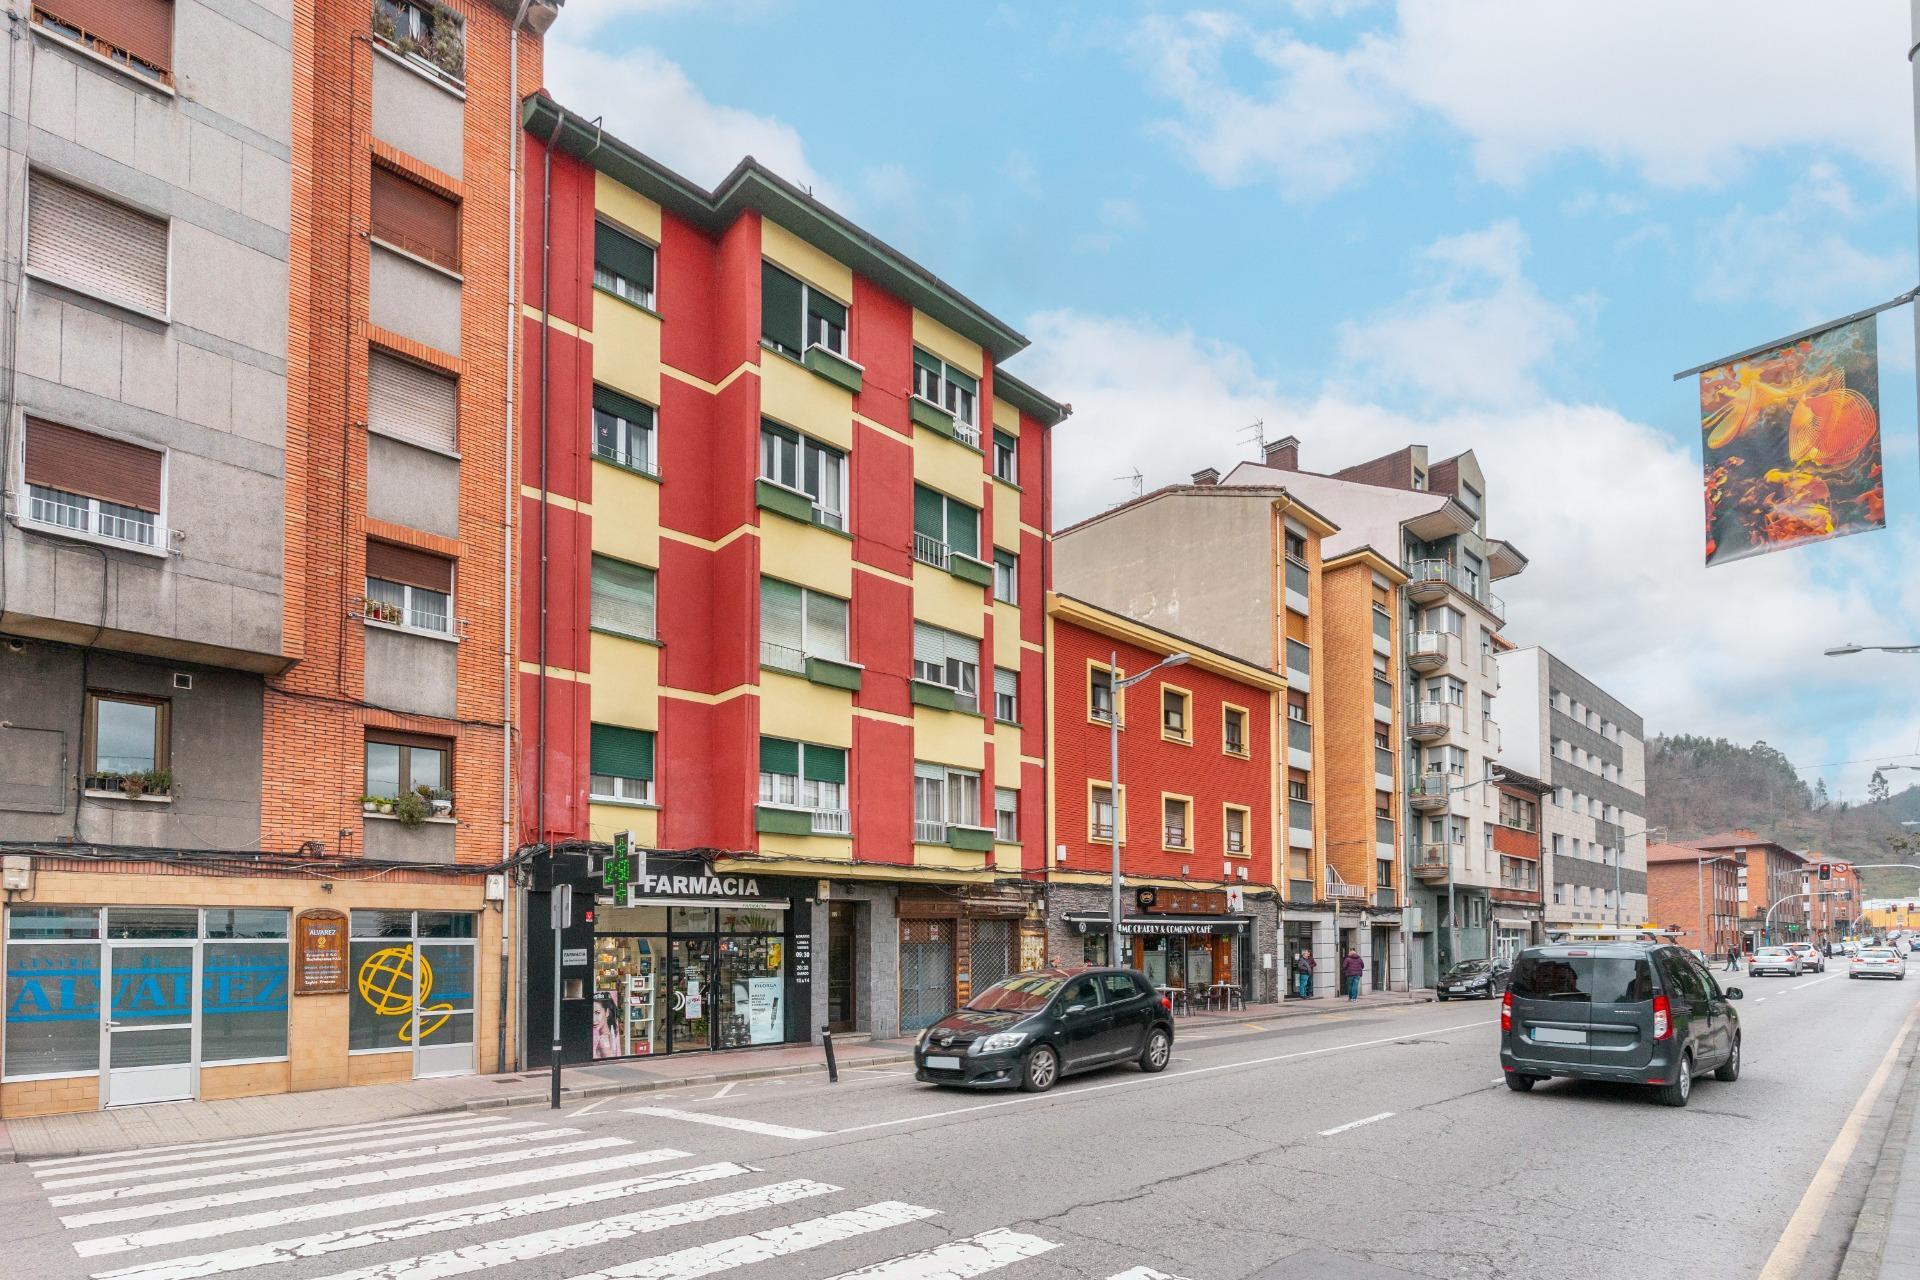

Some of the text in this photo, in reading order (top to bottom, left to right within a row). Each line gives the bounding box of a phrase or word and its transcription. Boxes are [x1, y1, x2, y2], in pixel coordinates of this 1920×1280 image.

[643, 875, 760, 896] FARMACIA
[1166, 925, 1195, 934] COMPANY
[10, 974, 288, 1011] ALVAREZ
